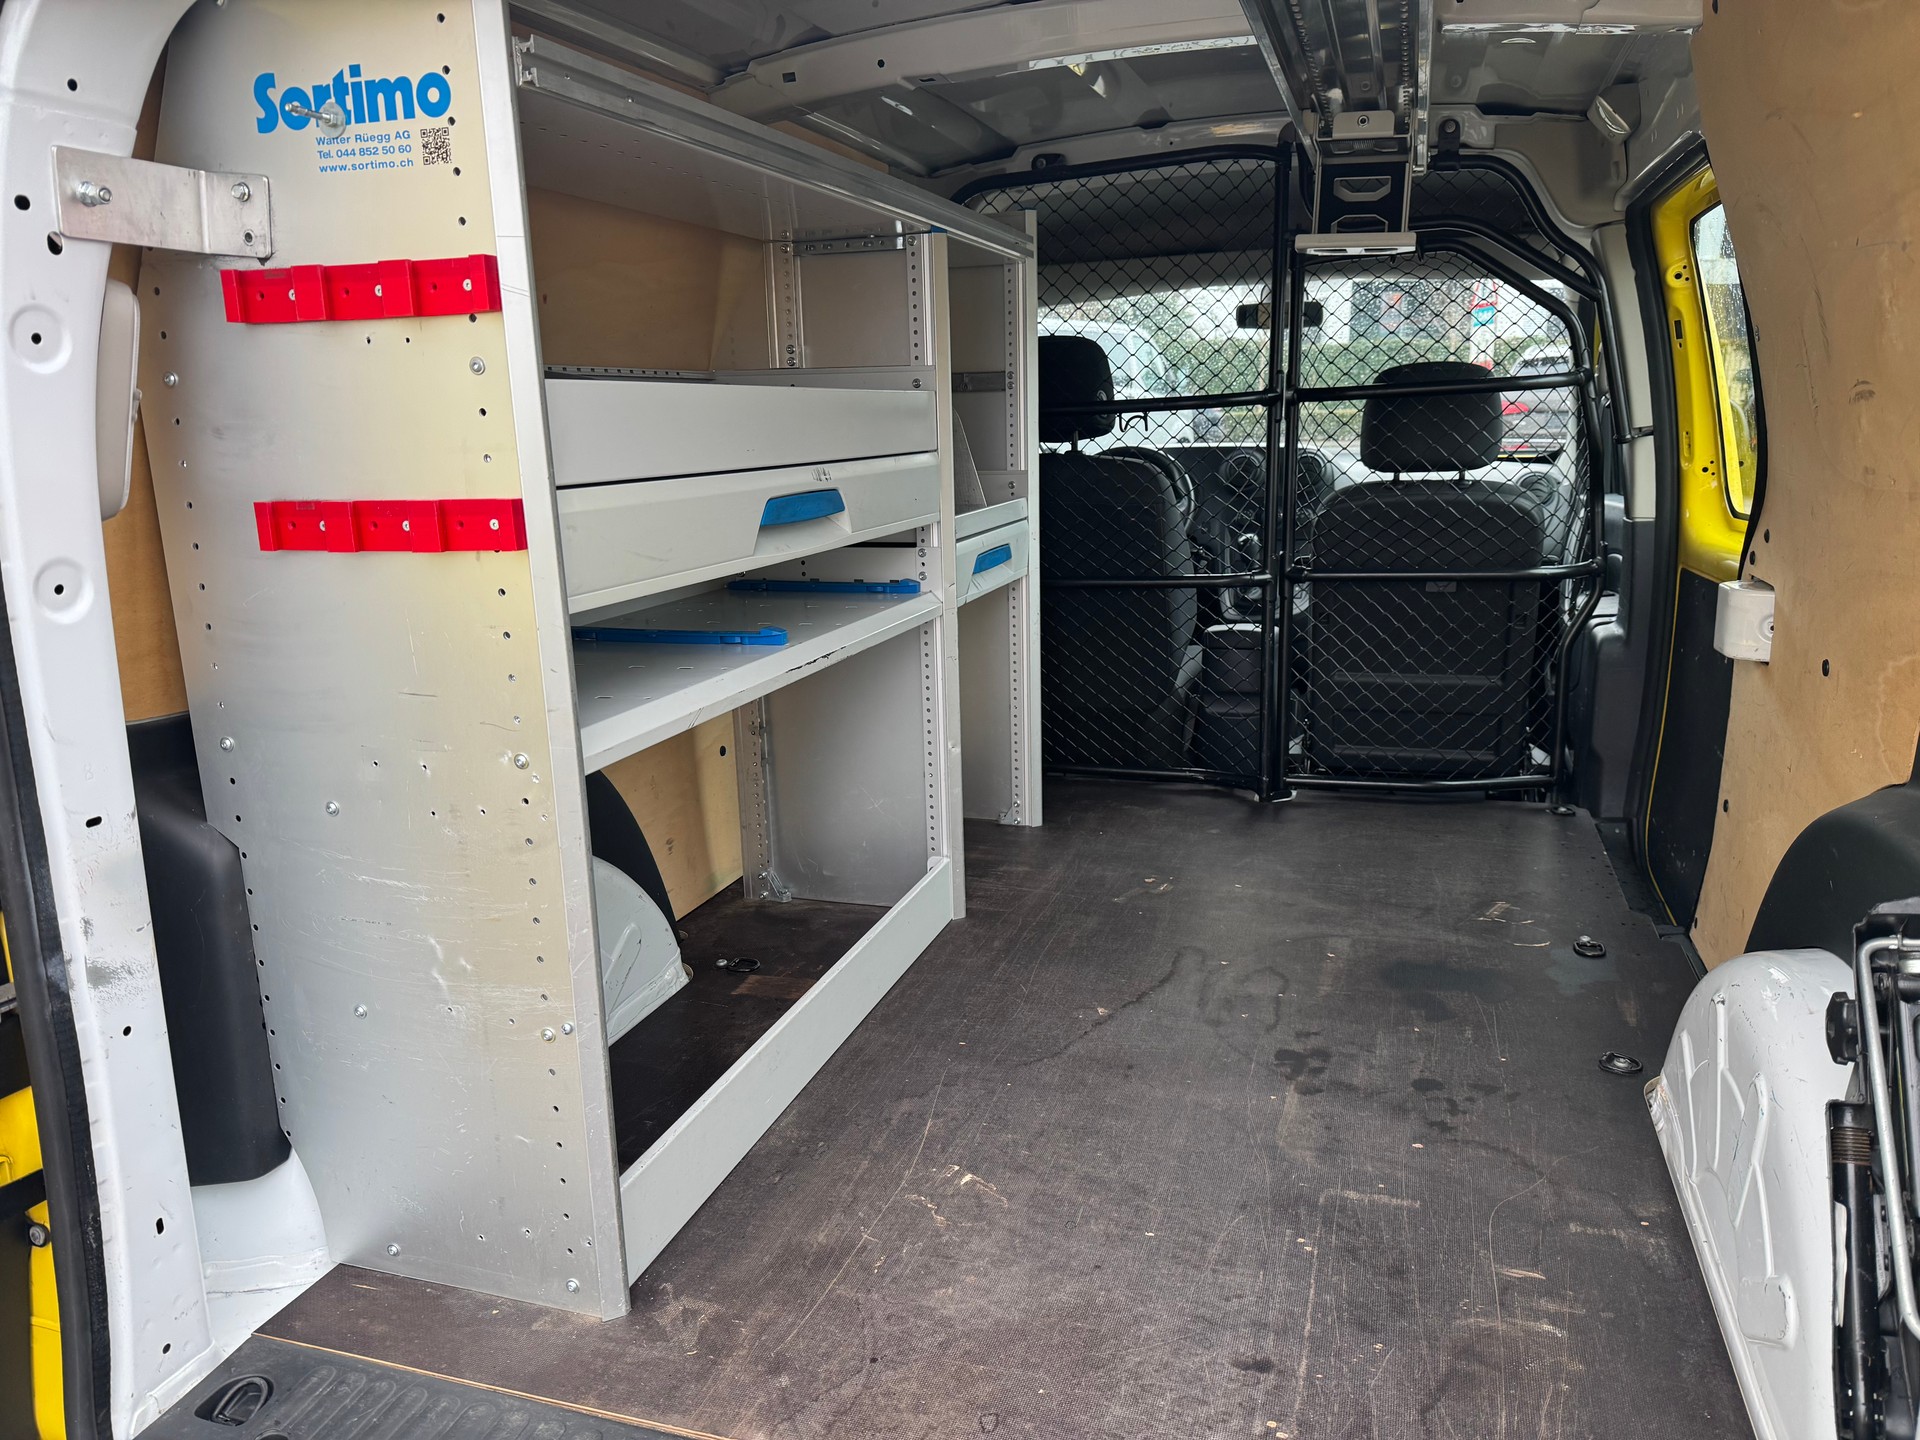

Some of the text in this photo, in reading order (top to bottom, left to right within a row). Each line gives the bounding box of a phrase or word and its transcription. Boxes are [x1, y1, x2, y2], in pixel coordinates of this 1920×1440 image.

[253, 63, 451, 134] Sortimo
[315, 130, 411, 146] Walter Rüegg AG
[317, 144, 412, 159] Tel. 044 852 50 60
[319, 158, 414, 173] www.sortimo.ch
